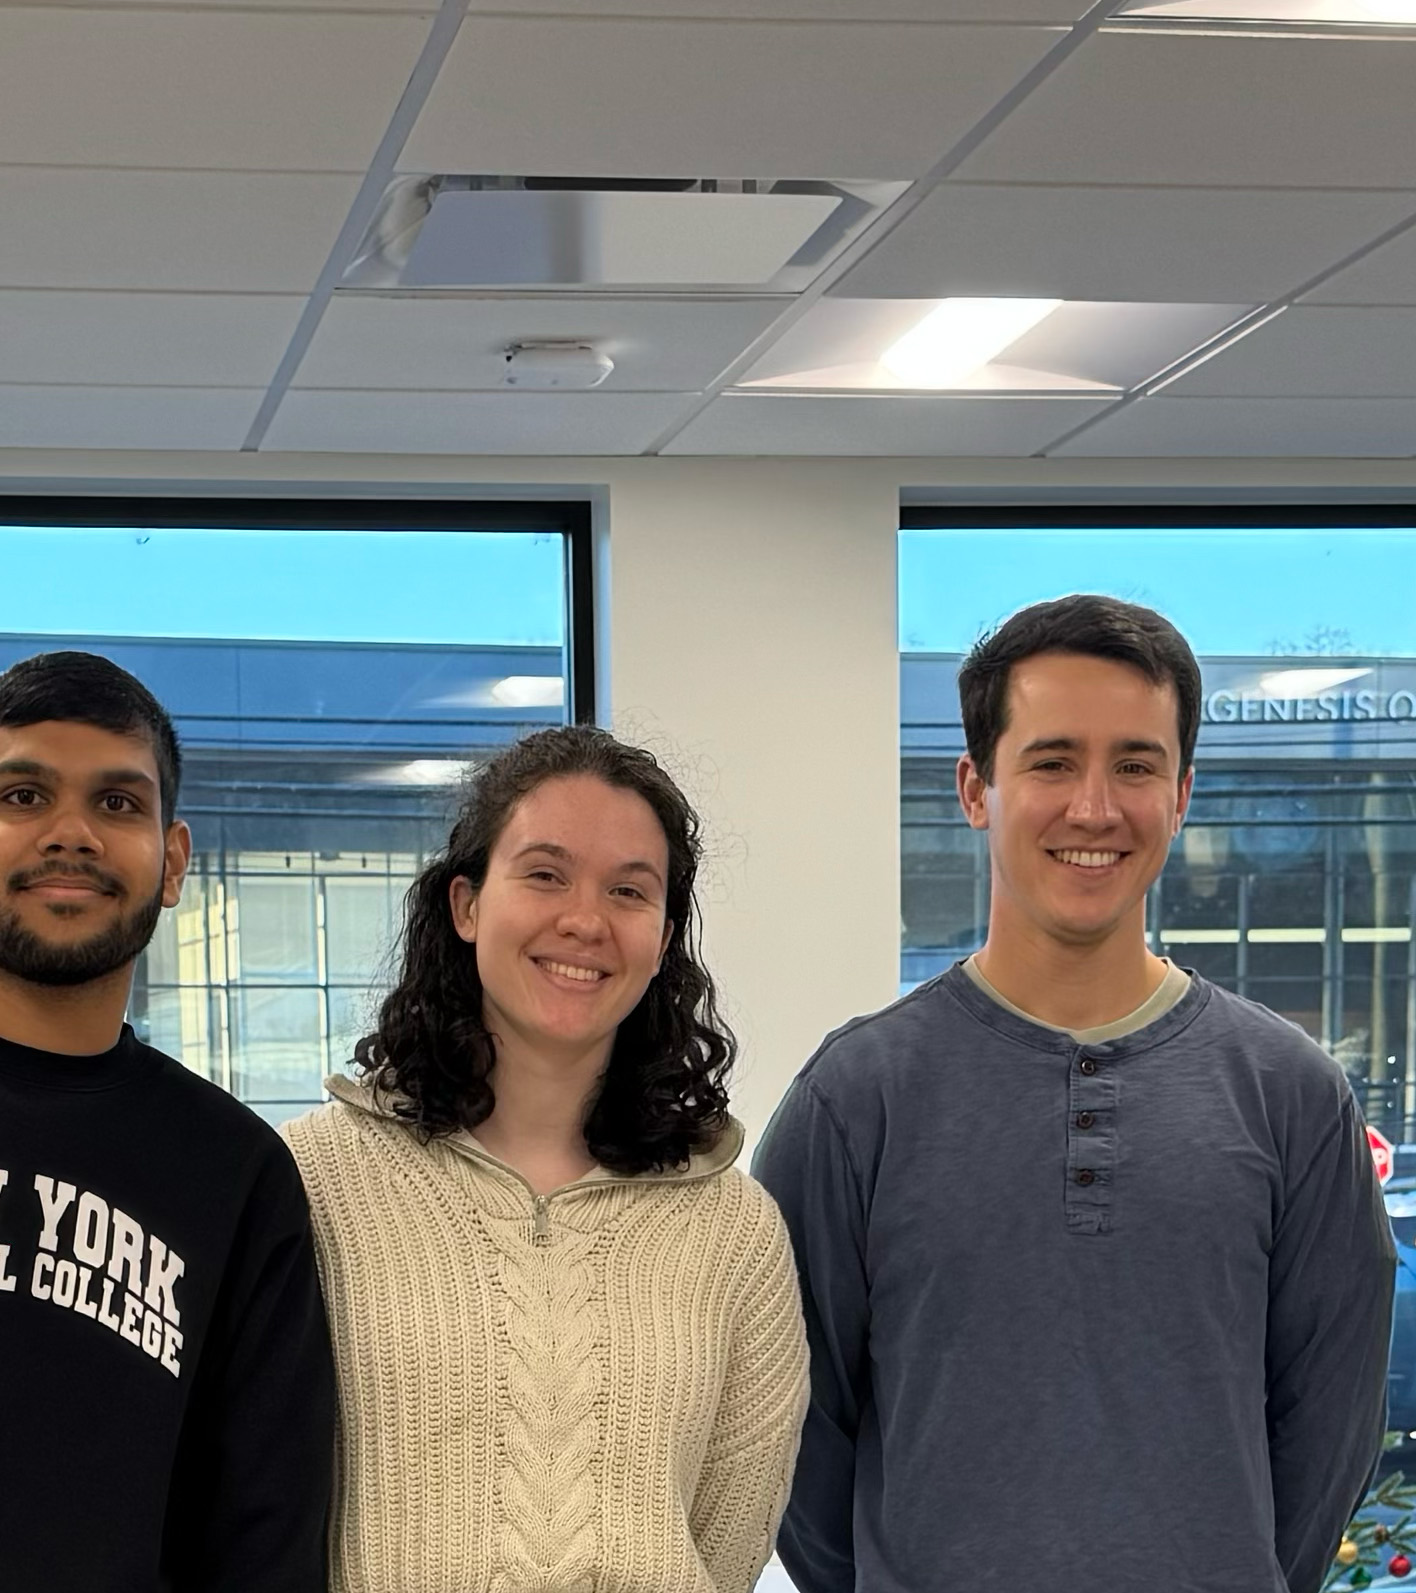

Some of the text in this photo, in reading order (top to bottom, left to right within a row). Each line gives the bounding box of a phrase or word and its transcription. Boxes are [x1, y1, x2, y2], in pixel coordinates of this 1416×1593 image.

[1206, 689, 1378, 722] GENESIS
[33, 1173, 186, 1327] YORK
[31, 1252, 185, 1379] COLLEGE
